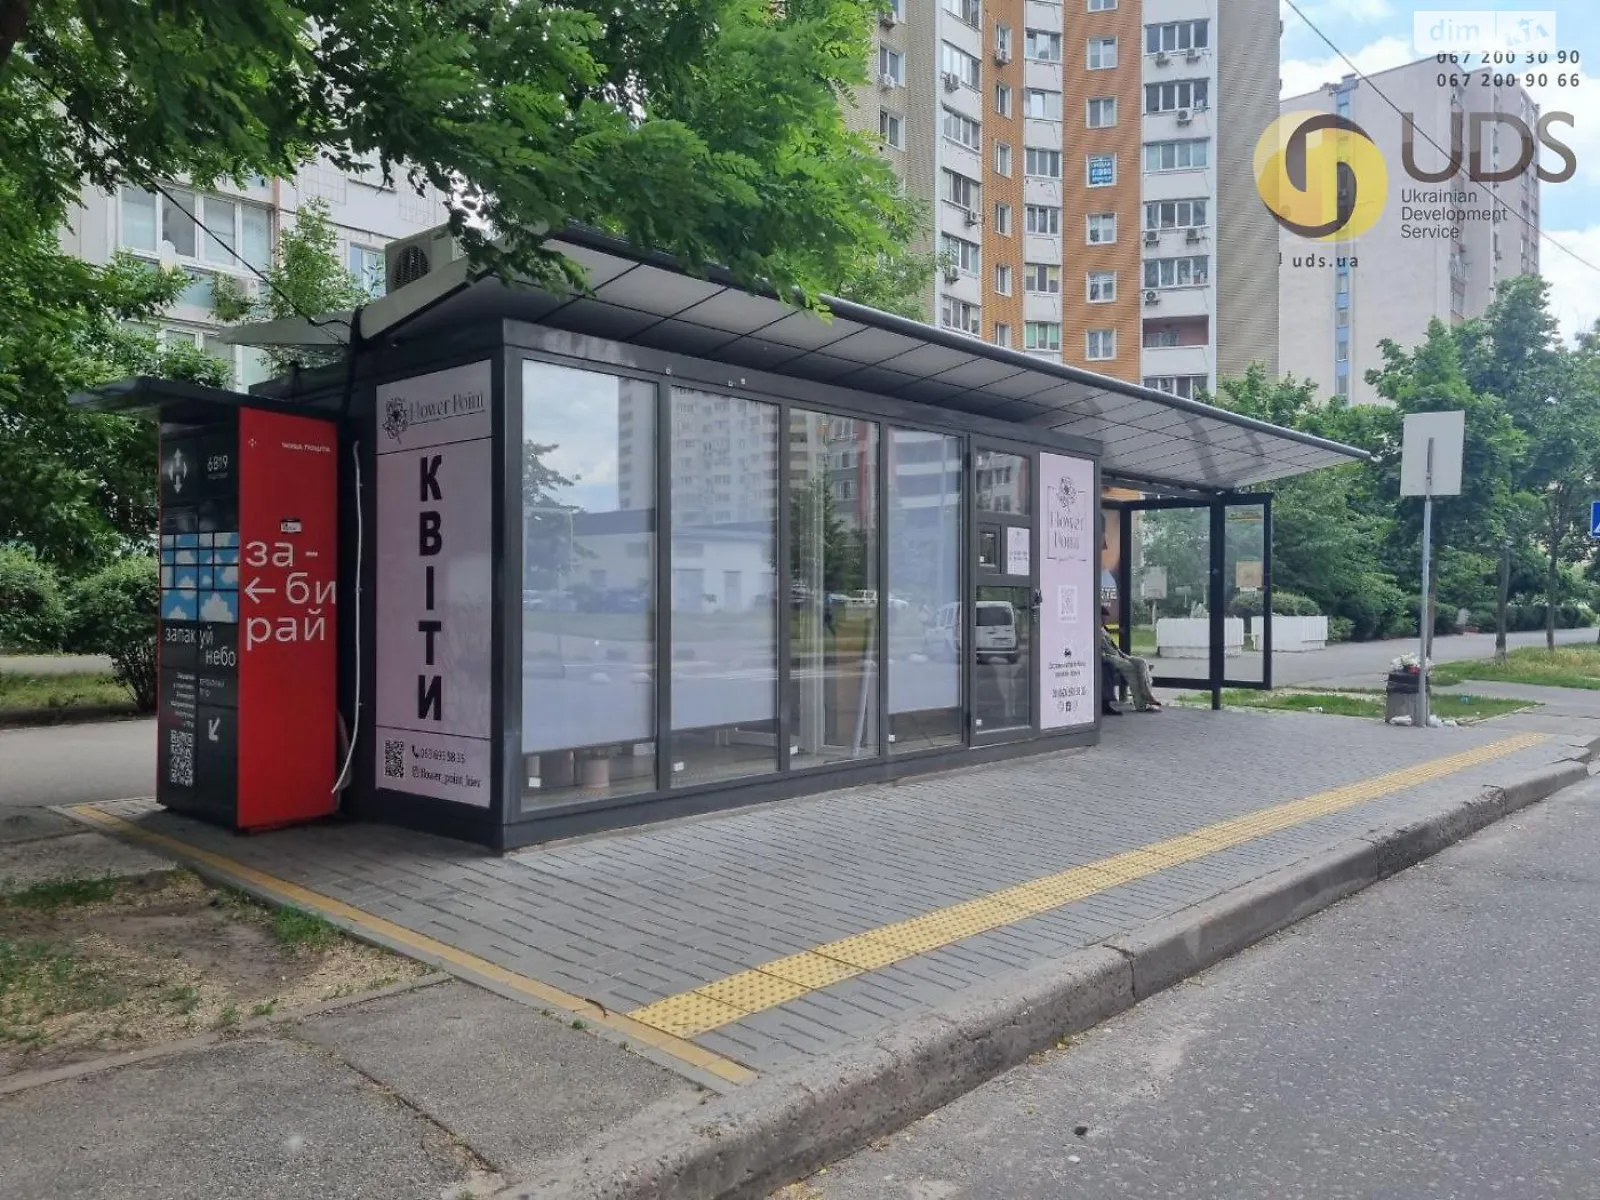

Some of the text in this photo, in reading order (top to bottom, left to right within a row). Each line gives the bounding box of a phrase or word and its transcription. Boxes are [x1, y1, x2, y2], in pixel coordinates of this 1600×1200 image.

[207, 454, 229, 472] 6819
[285, 572, 336, 605] би
[417, 454, 443, 722] КВІТИ
[246, 608, 325, 652] рай
[205, 646, 237, 667] небо
